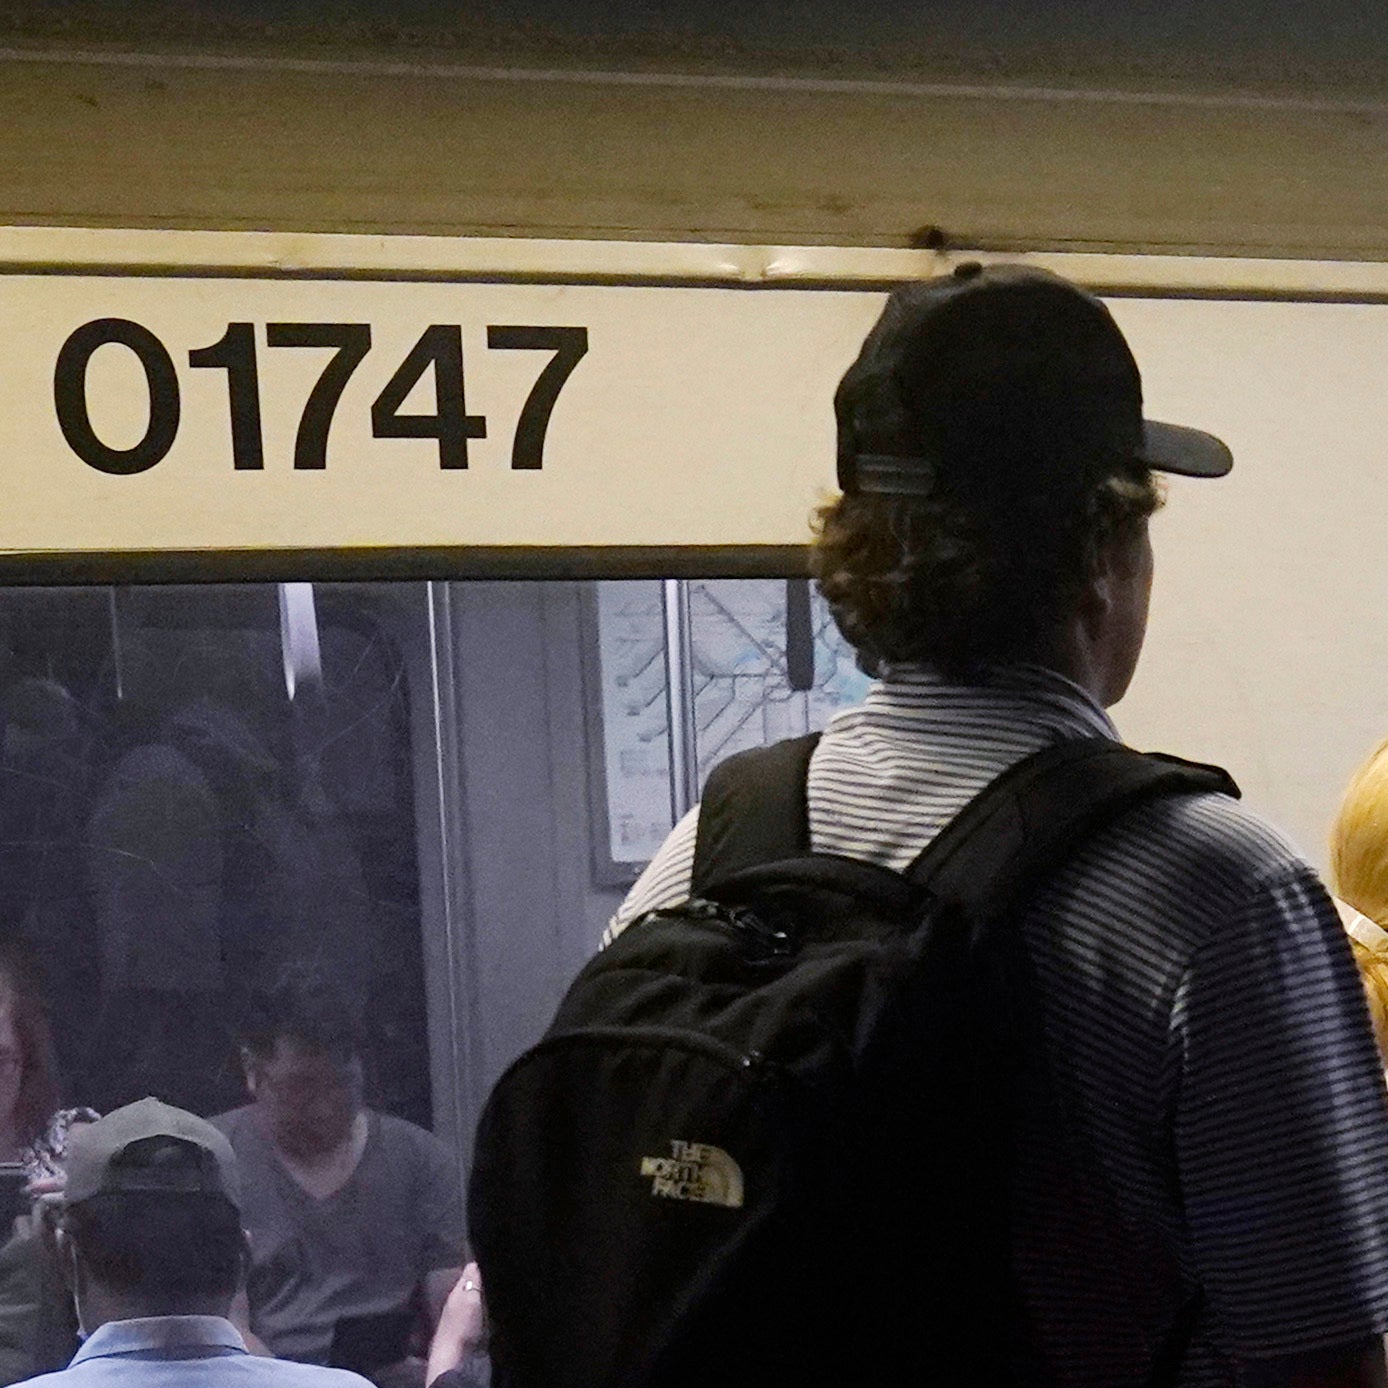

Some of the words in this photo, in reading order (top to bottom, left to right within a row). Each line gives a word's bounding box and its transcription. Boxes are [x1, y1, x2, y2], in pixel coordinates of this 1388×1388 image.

[54, 318, 589, 475] 01747
[670, 1139, 709, 1161] THE
[640, 1156, 708, 1182] NORTH
[651, 1177, 706, 1201] FACE
